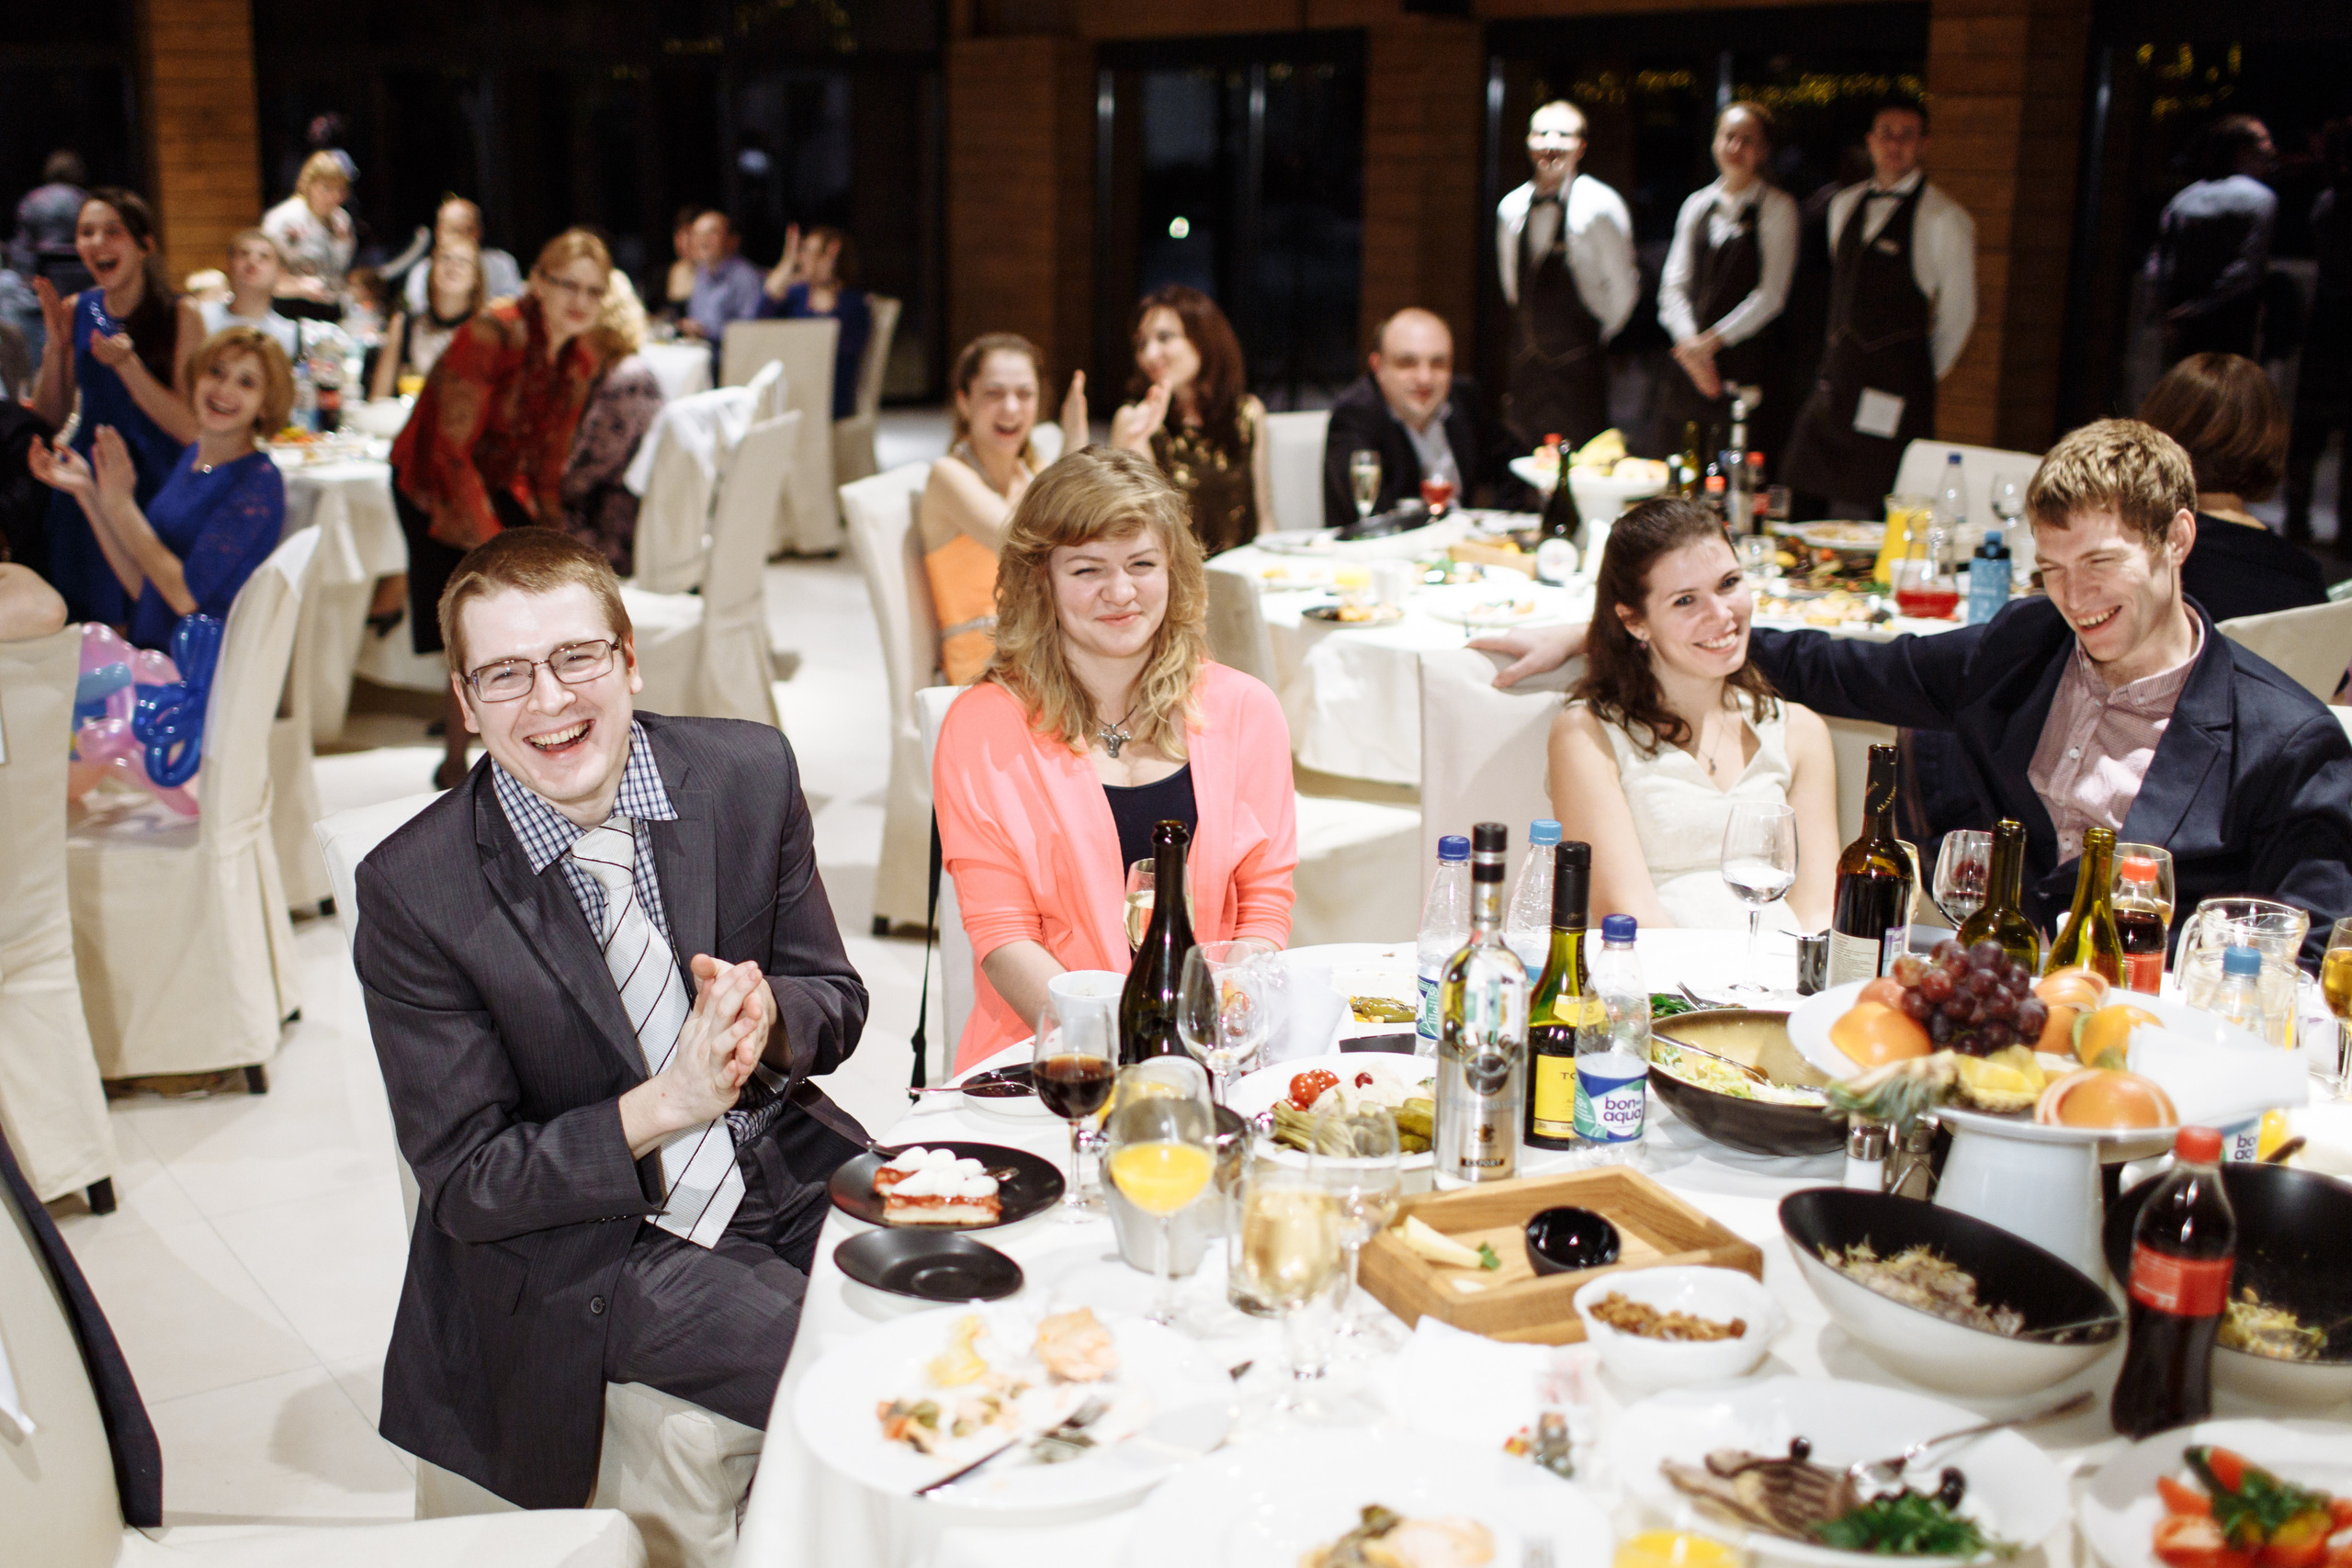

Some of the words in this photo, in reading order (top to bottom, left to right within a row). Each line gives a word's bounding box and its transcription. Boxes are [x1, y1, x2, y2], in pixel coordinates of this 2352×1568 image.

[1605, 1096, 1635, 1110] bon
[1603, 1108, 1641, 1124] aqua
[2236, 1134, 2257, 1148] bo
[2234, 1148, 2255, 1161] aq
